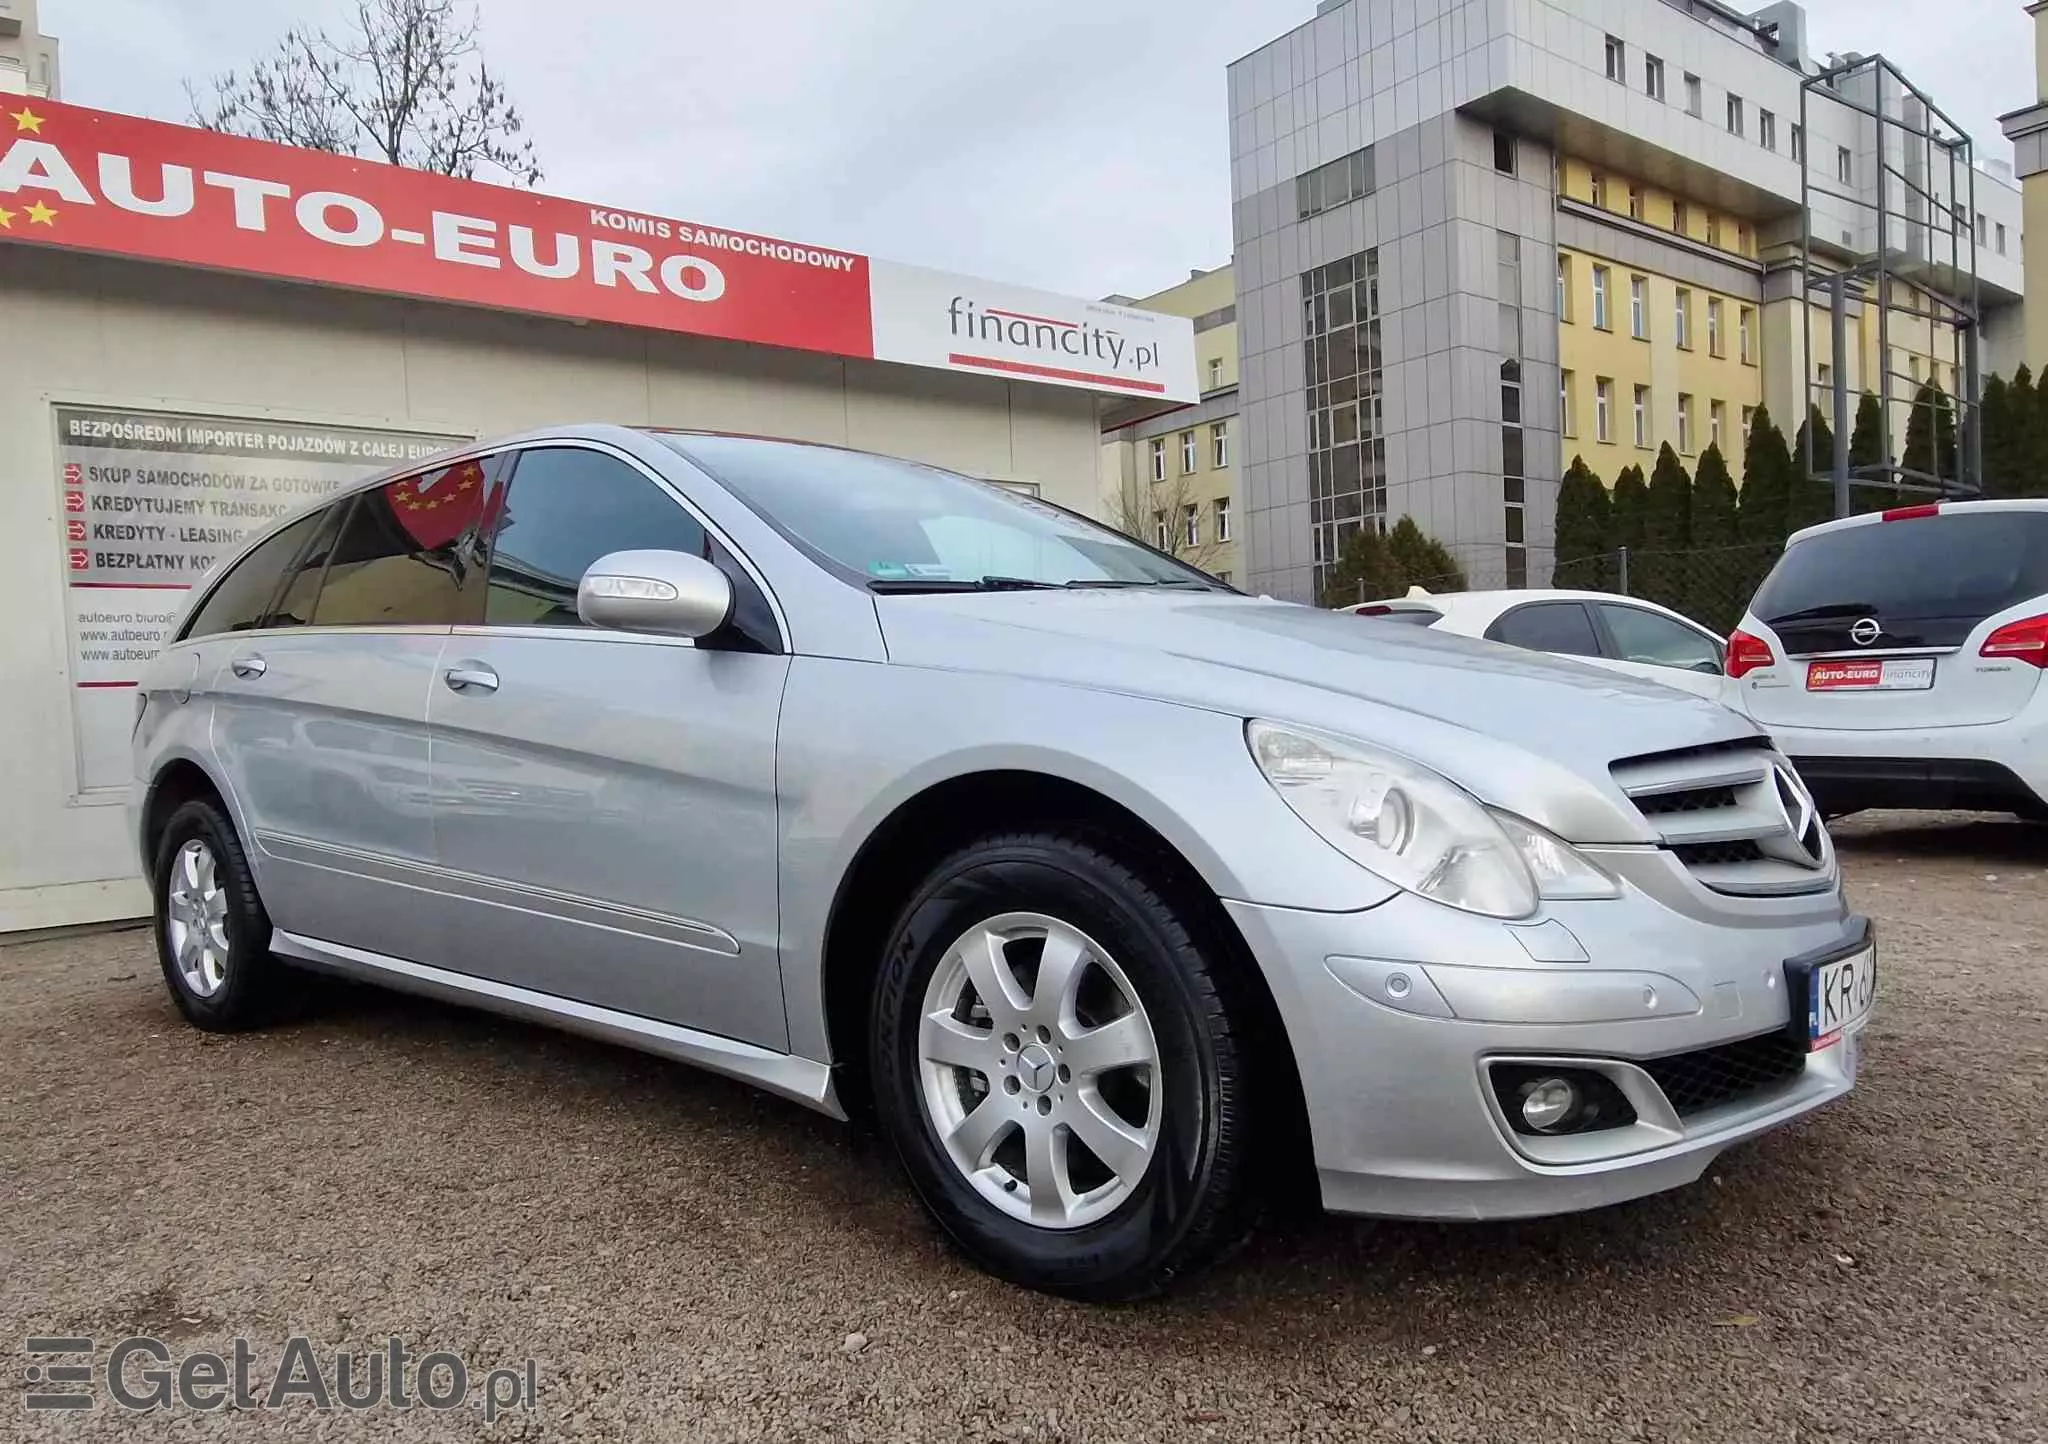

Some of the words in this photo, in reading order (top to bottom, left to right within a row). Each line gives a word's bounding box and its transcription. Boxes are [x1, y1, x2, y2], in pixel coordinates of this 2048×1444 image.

[0, 138, 725, 302] AUTO-EURO
[590, 209, 671, 238] KOMIS
[679, 226, 855, 272] SAMOCHODOWY
[949, 297, 1159, 370] financity.pl
[70, 419, 181, 443] BEZPOŚREDNI
[188, 428, 264, 449] IMPORTER
[268, 434, 346, 455] POJAZDÓW
[350, 441, 359, 455] Z
[363, 442, 404, 458] CAŁEJ
[89, 466, 131, 483] SKUP
[251, 476, 268, 491] ZA
[91, 495, 204, 515] KREDYTUJEMY
[94, 524, 165, 541] KREDYTY
[96, 552, 184, 569] BEZPŁATNY
[191, 555, 216, 570] KO
[1814, 669, 1878, 680] AUTO-EURO
